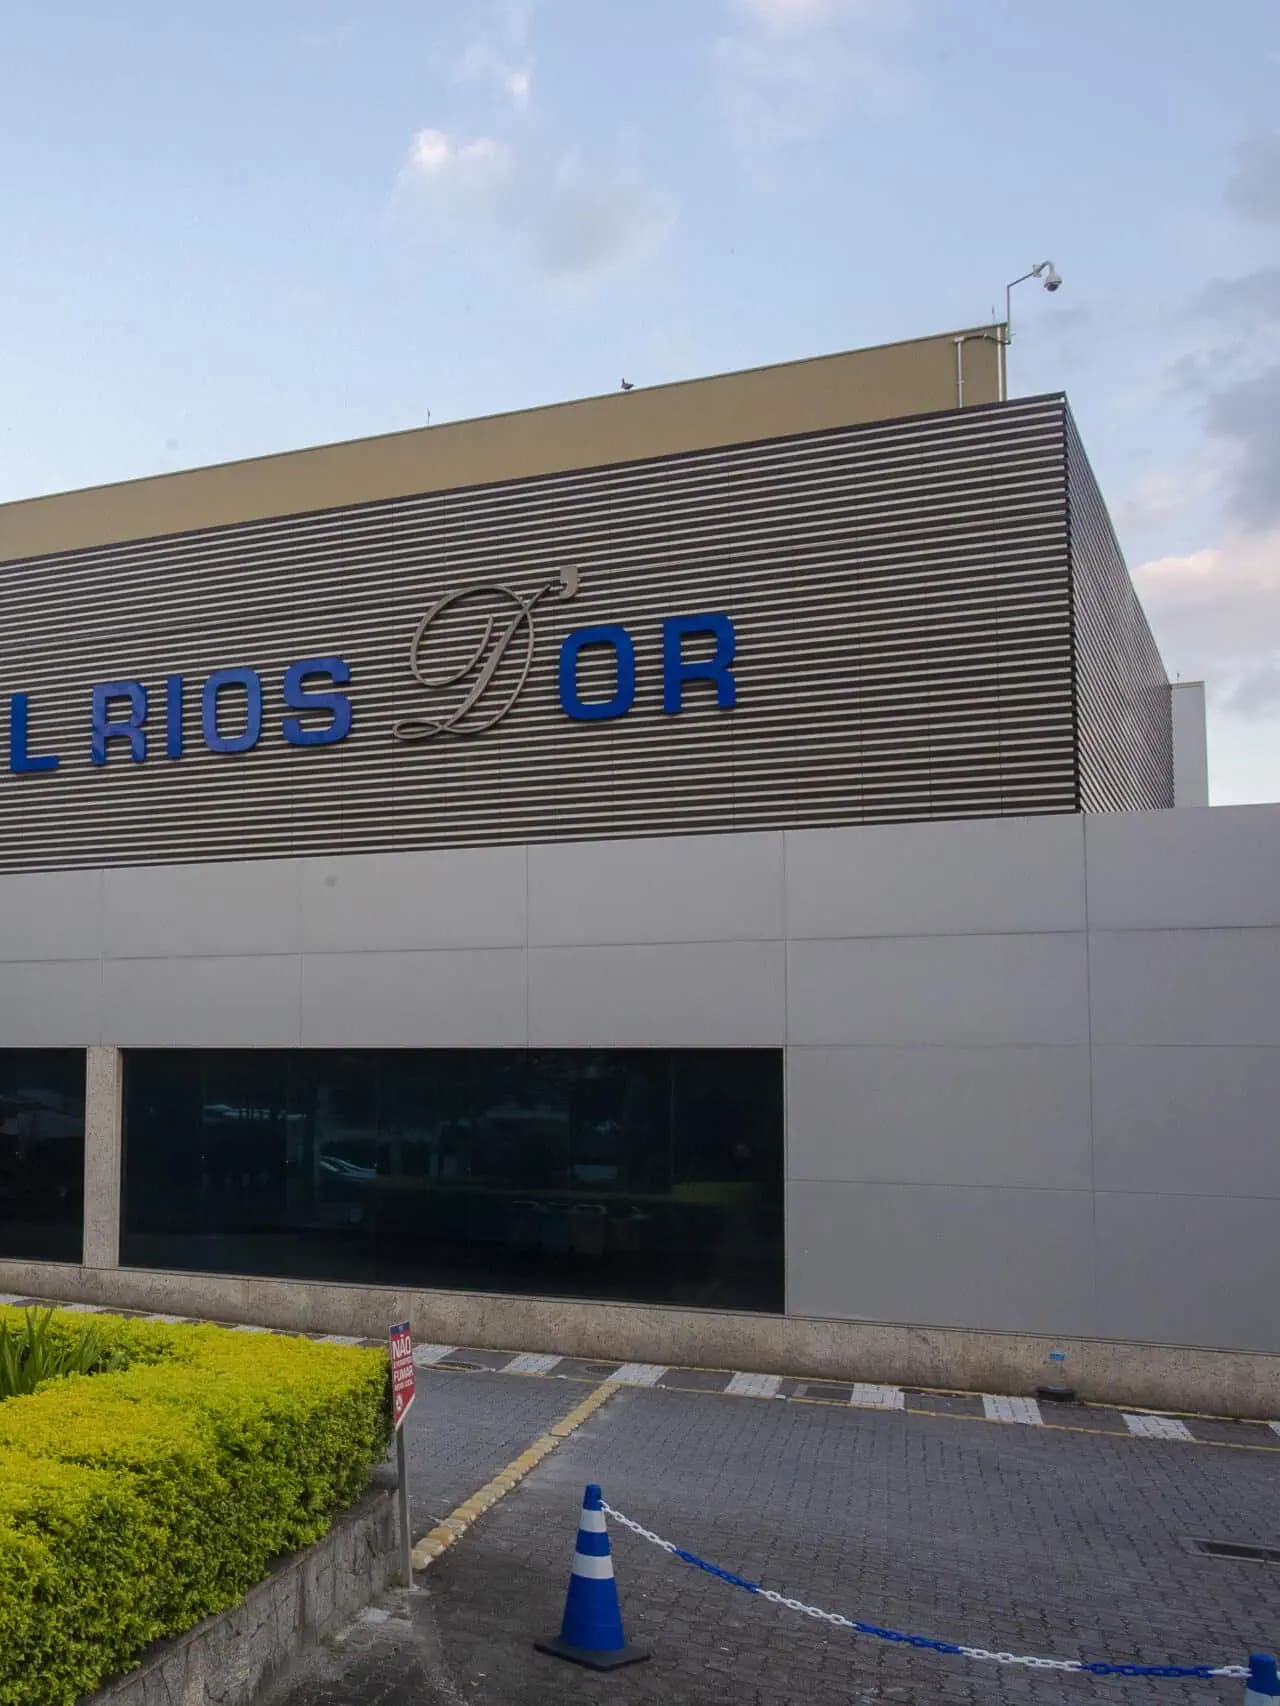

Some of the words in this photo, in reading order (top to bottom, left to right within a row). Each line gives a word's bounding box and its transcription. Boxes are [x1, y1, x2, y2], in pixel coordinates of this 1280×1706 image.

[91, 656, 353, 766] RIOS
[392, 1334, 411, 1360] NÃO
[393, 1364, 414, 1381] FUMAR
